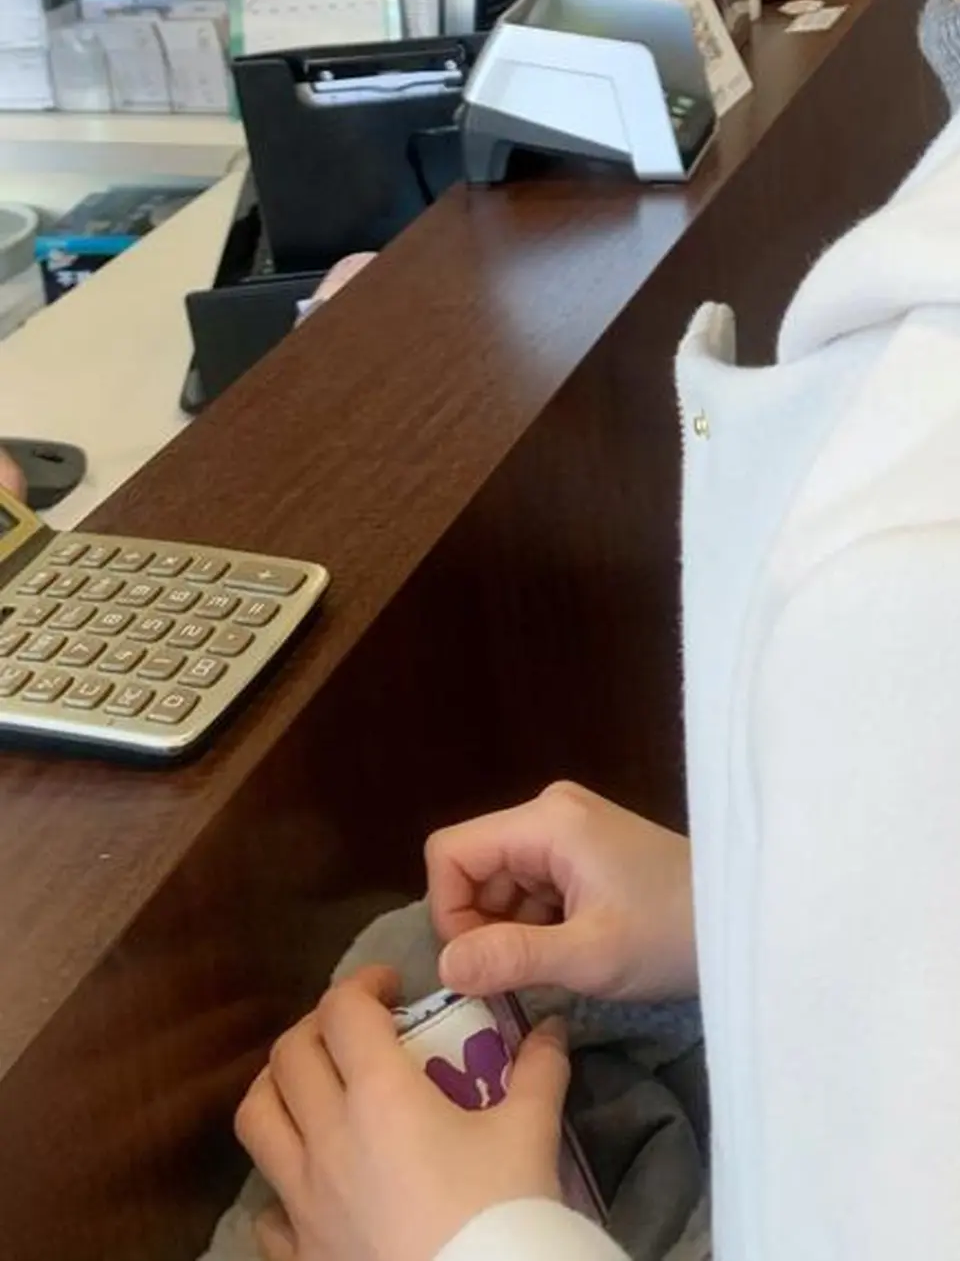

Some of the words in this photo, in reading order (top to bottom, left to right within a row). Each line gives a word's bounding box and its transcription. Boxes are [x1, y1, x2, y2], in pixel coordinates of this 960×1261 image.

[205, 595, 230, 608] 3
[102, 613, 124, 625] 8
[140, 618, 164, 631] 5
[179, 624, 204, 637] 2
[191, 658, 214, 677] 00
[162, 693, 185, 708] 0
